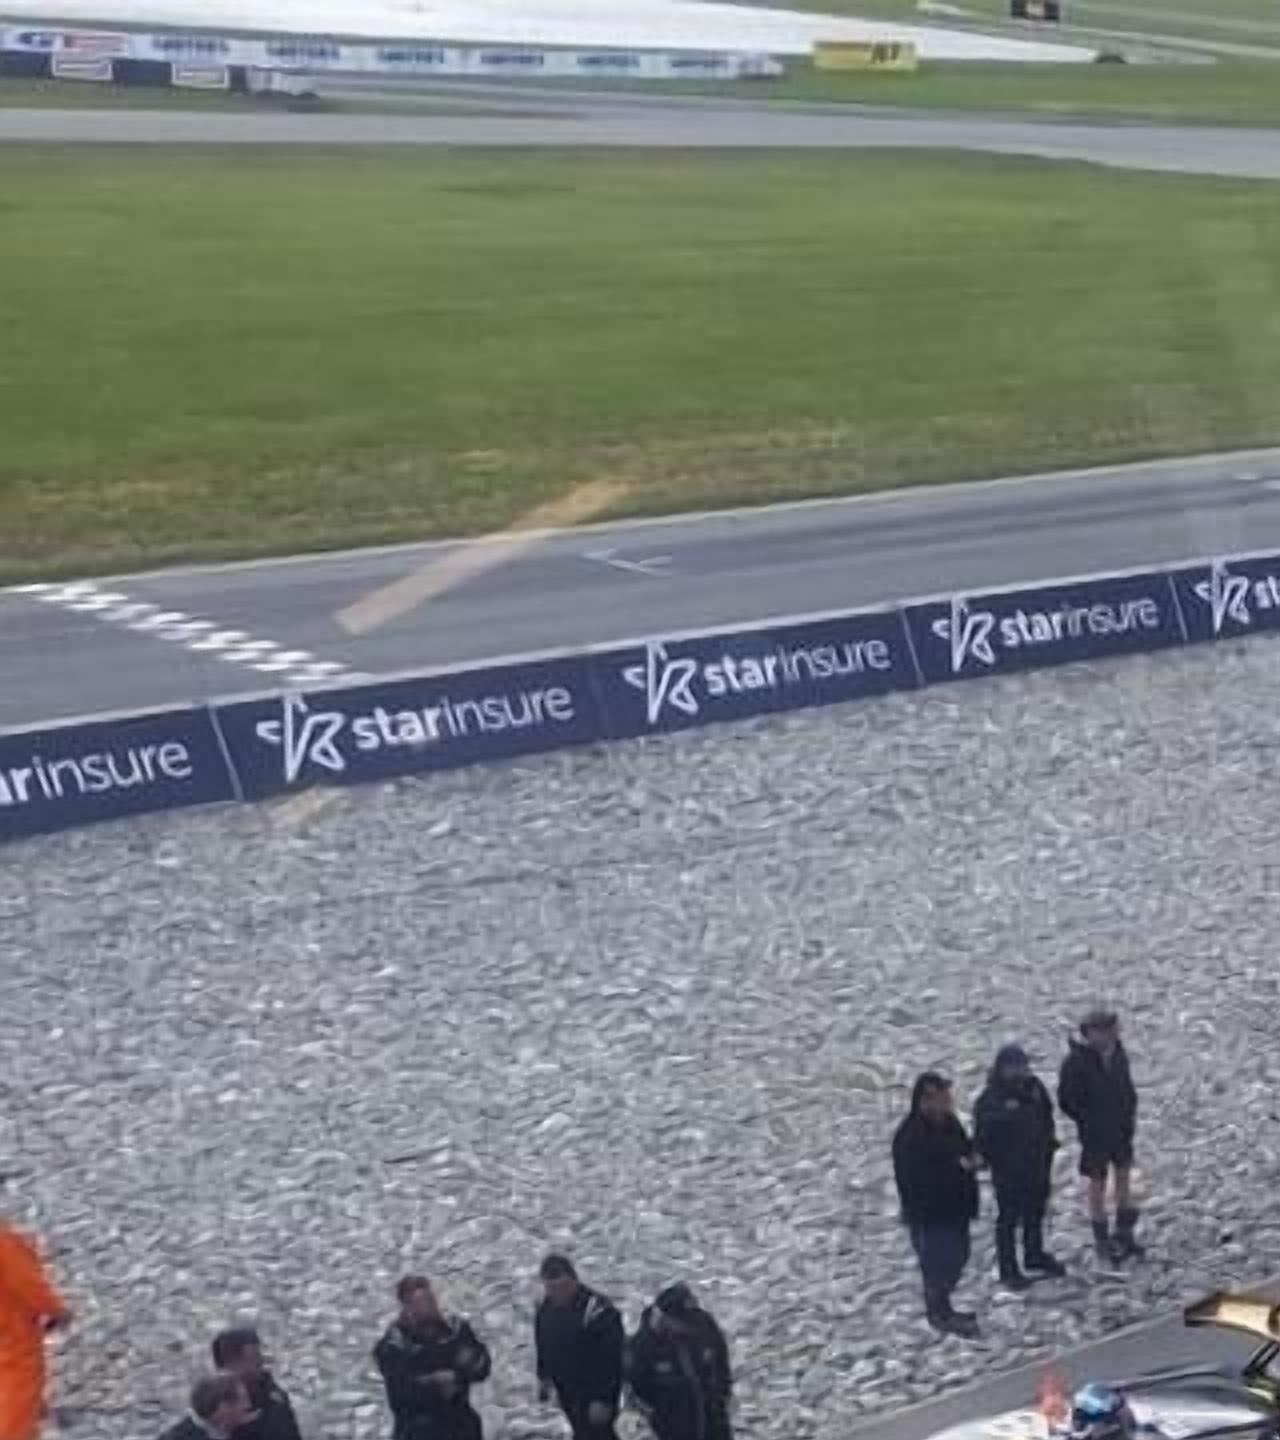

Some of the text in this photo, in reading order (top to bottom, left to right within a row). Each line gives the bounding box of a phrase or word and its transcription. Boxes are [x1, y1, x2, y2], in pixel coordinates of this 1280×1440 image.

[999, 596, 1159, 647] starinsure
[704, 637, 891, 696] starinsure
[354, 685, 573, 750] starinsure
